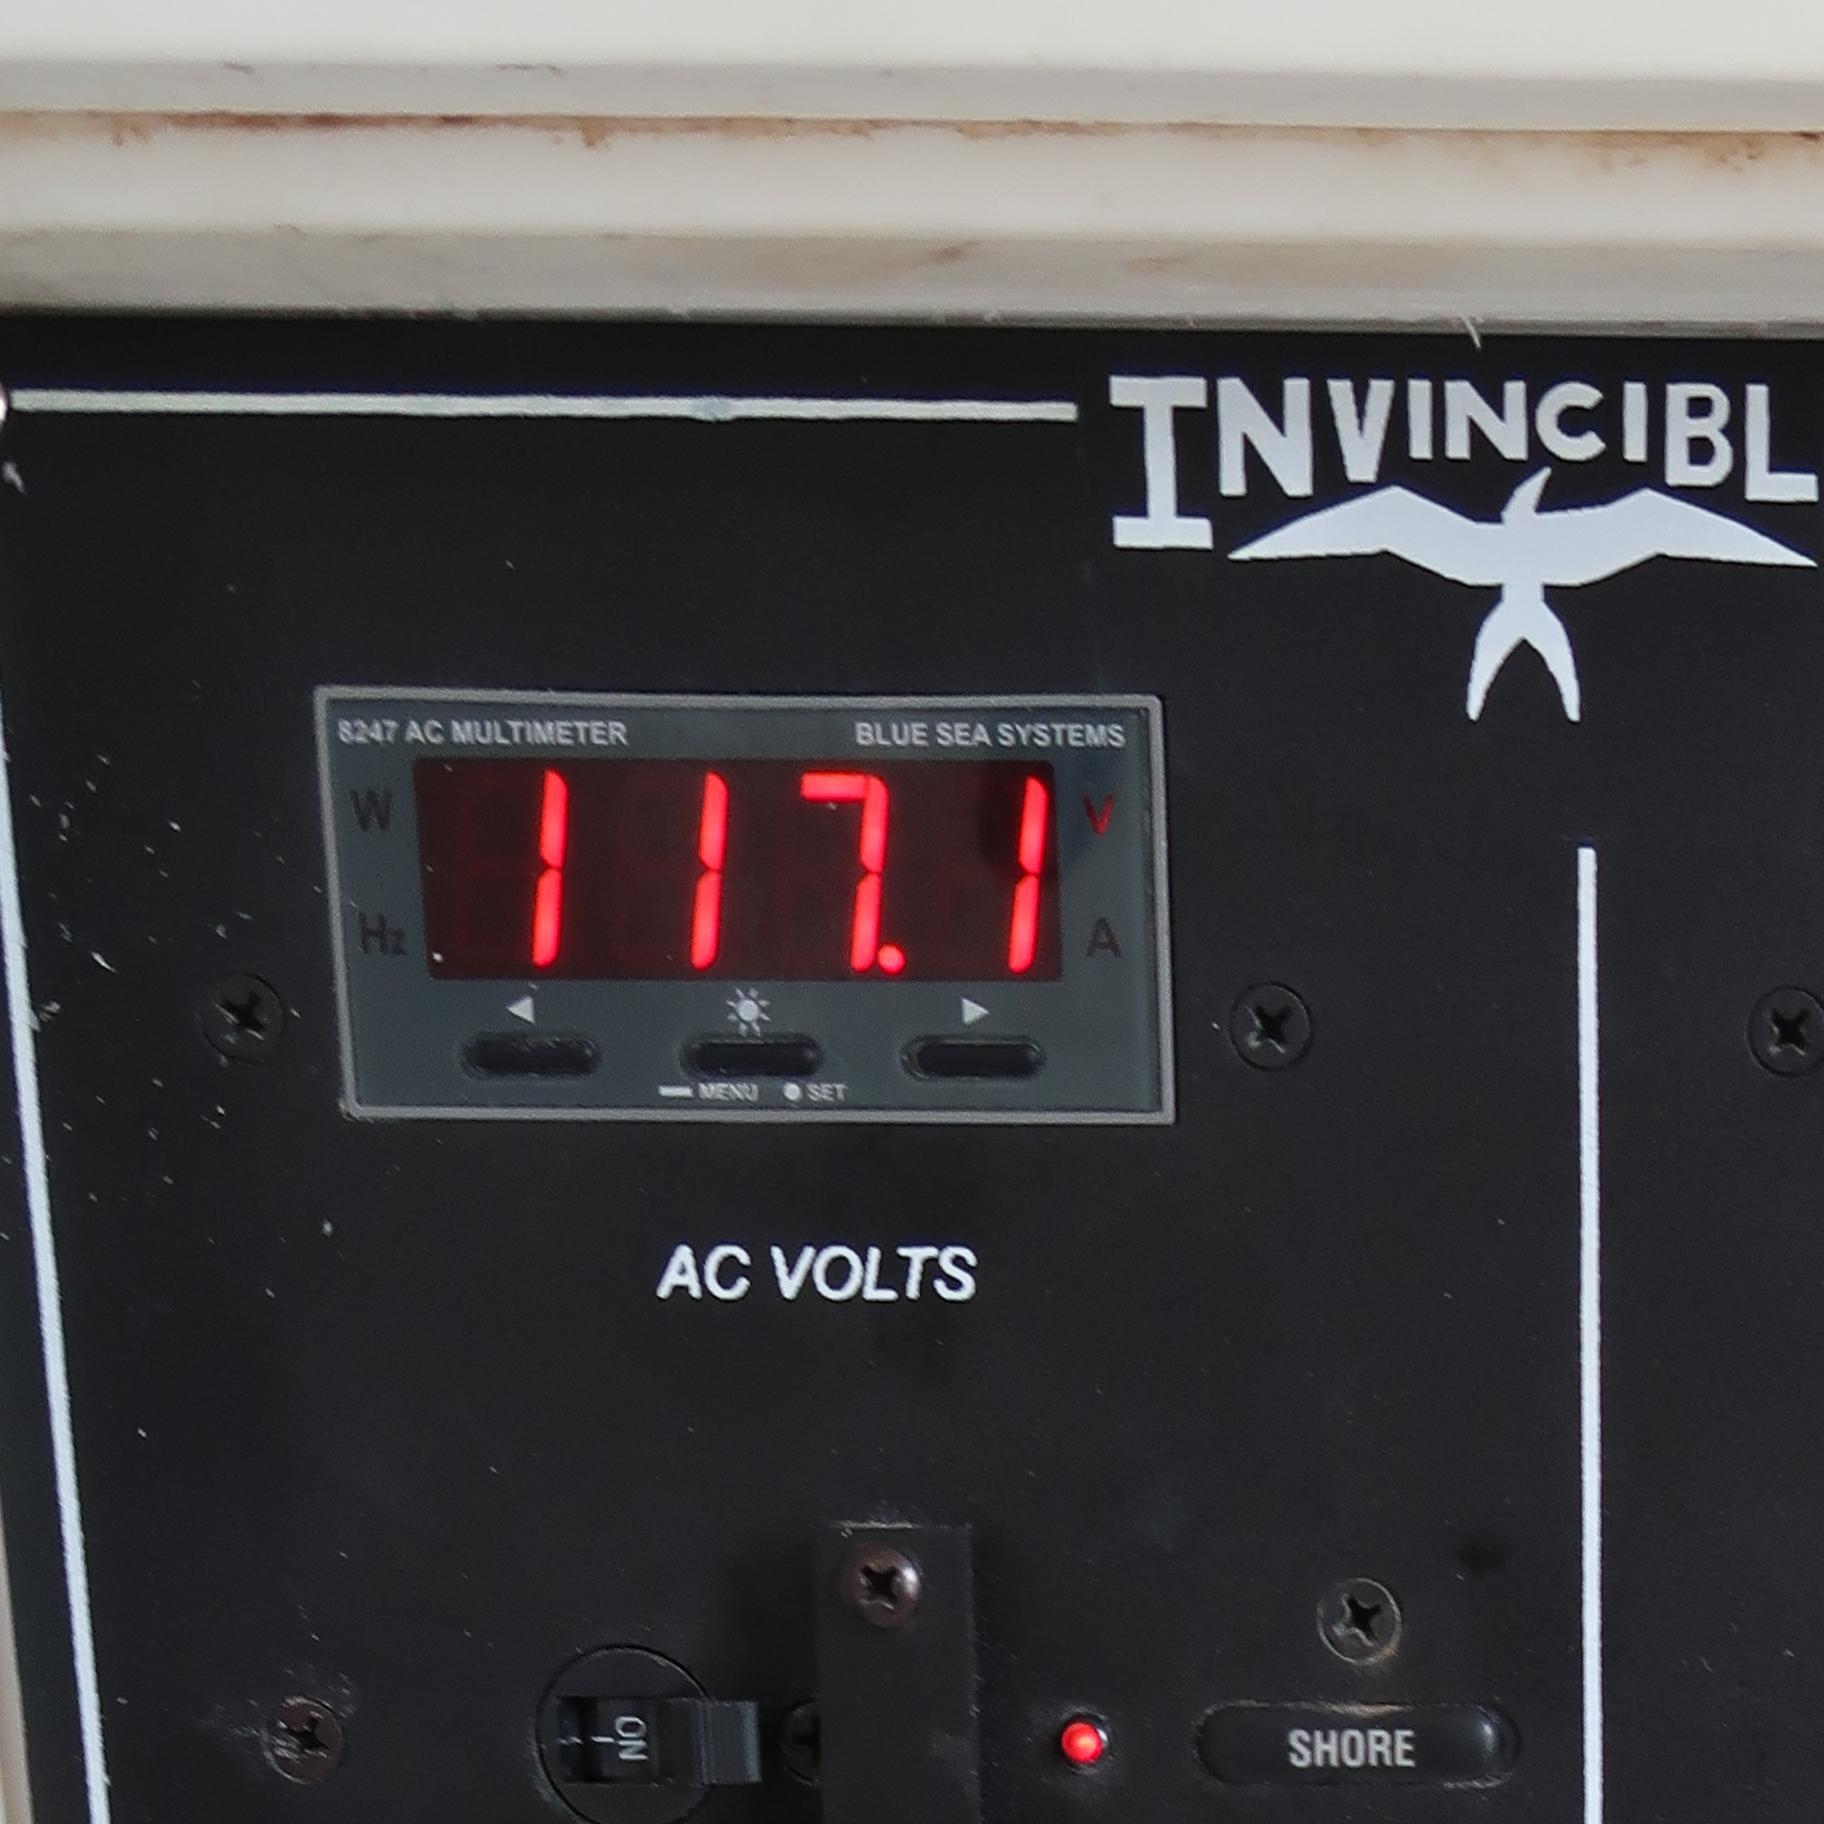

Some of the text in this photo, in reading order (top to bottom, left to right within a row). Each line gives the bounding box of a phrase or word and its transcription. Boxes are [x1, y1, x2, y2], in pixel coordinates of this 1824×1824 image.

[337, 719, 628, 745] 8247 AC MULTIMETER
[855, 722, 1126, 748] BLUE SEA SYSTEMS
[1082, 794, 1116, 838] V
[531, 770, 1048, 972] 117.1
[698, 1082, 758, 1101] MENU
[806, 1083, 847, 1102] SET
[656, 1244, 977, 1301] AC VOLTS
[615, 1716, 648, 1760] ON
[1289, 1729, 1415, 1767] SHORE
